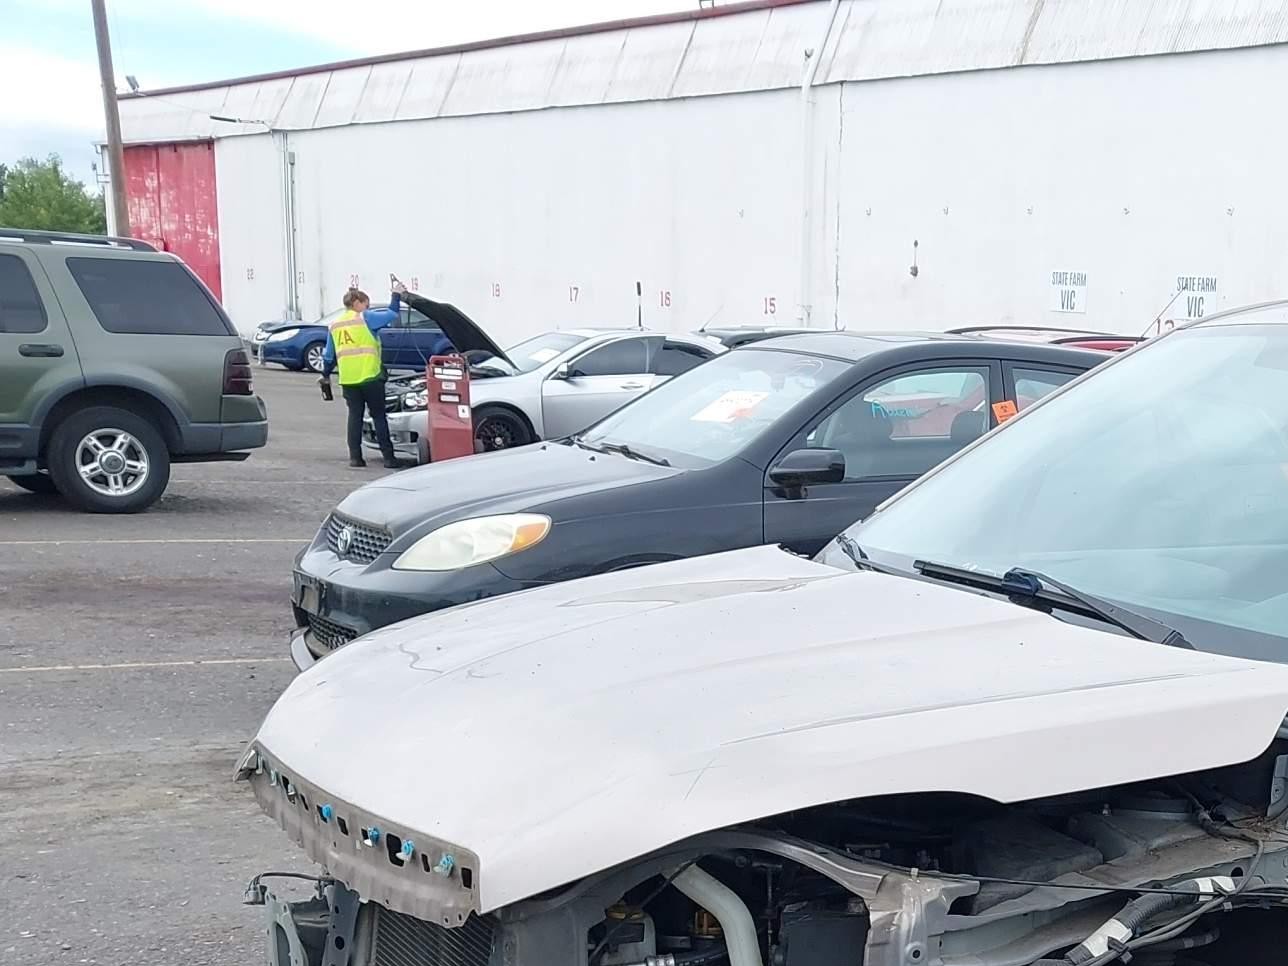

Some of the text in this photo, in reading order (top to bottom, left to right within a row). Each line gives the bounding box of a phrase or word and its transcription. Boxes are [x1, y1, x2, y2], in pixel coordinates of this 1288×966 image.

[350, 274, 359, 288] 20
[1051, 271, 1087, 288] STATE FARM
[1176, 276, 1217, 293] STATE FARM
[491, 282, 501, 298] 18
[569, 286, 579, 302] 17
[660, 290, 672, 307] 16
[763, 297, 777, 315] 15
[1060, 289, 1076, 311] VIC
[1186, 295, 1205, 318] VIC
